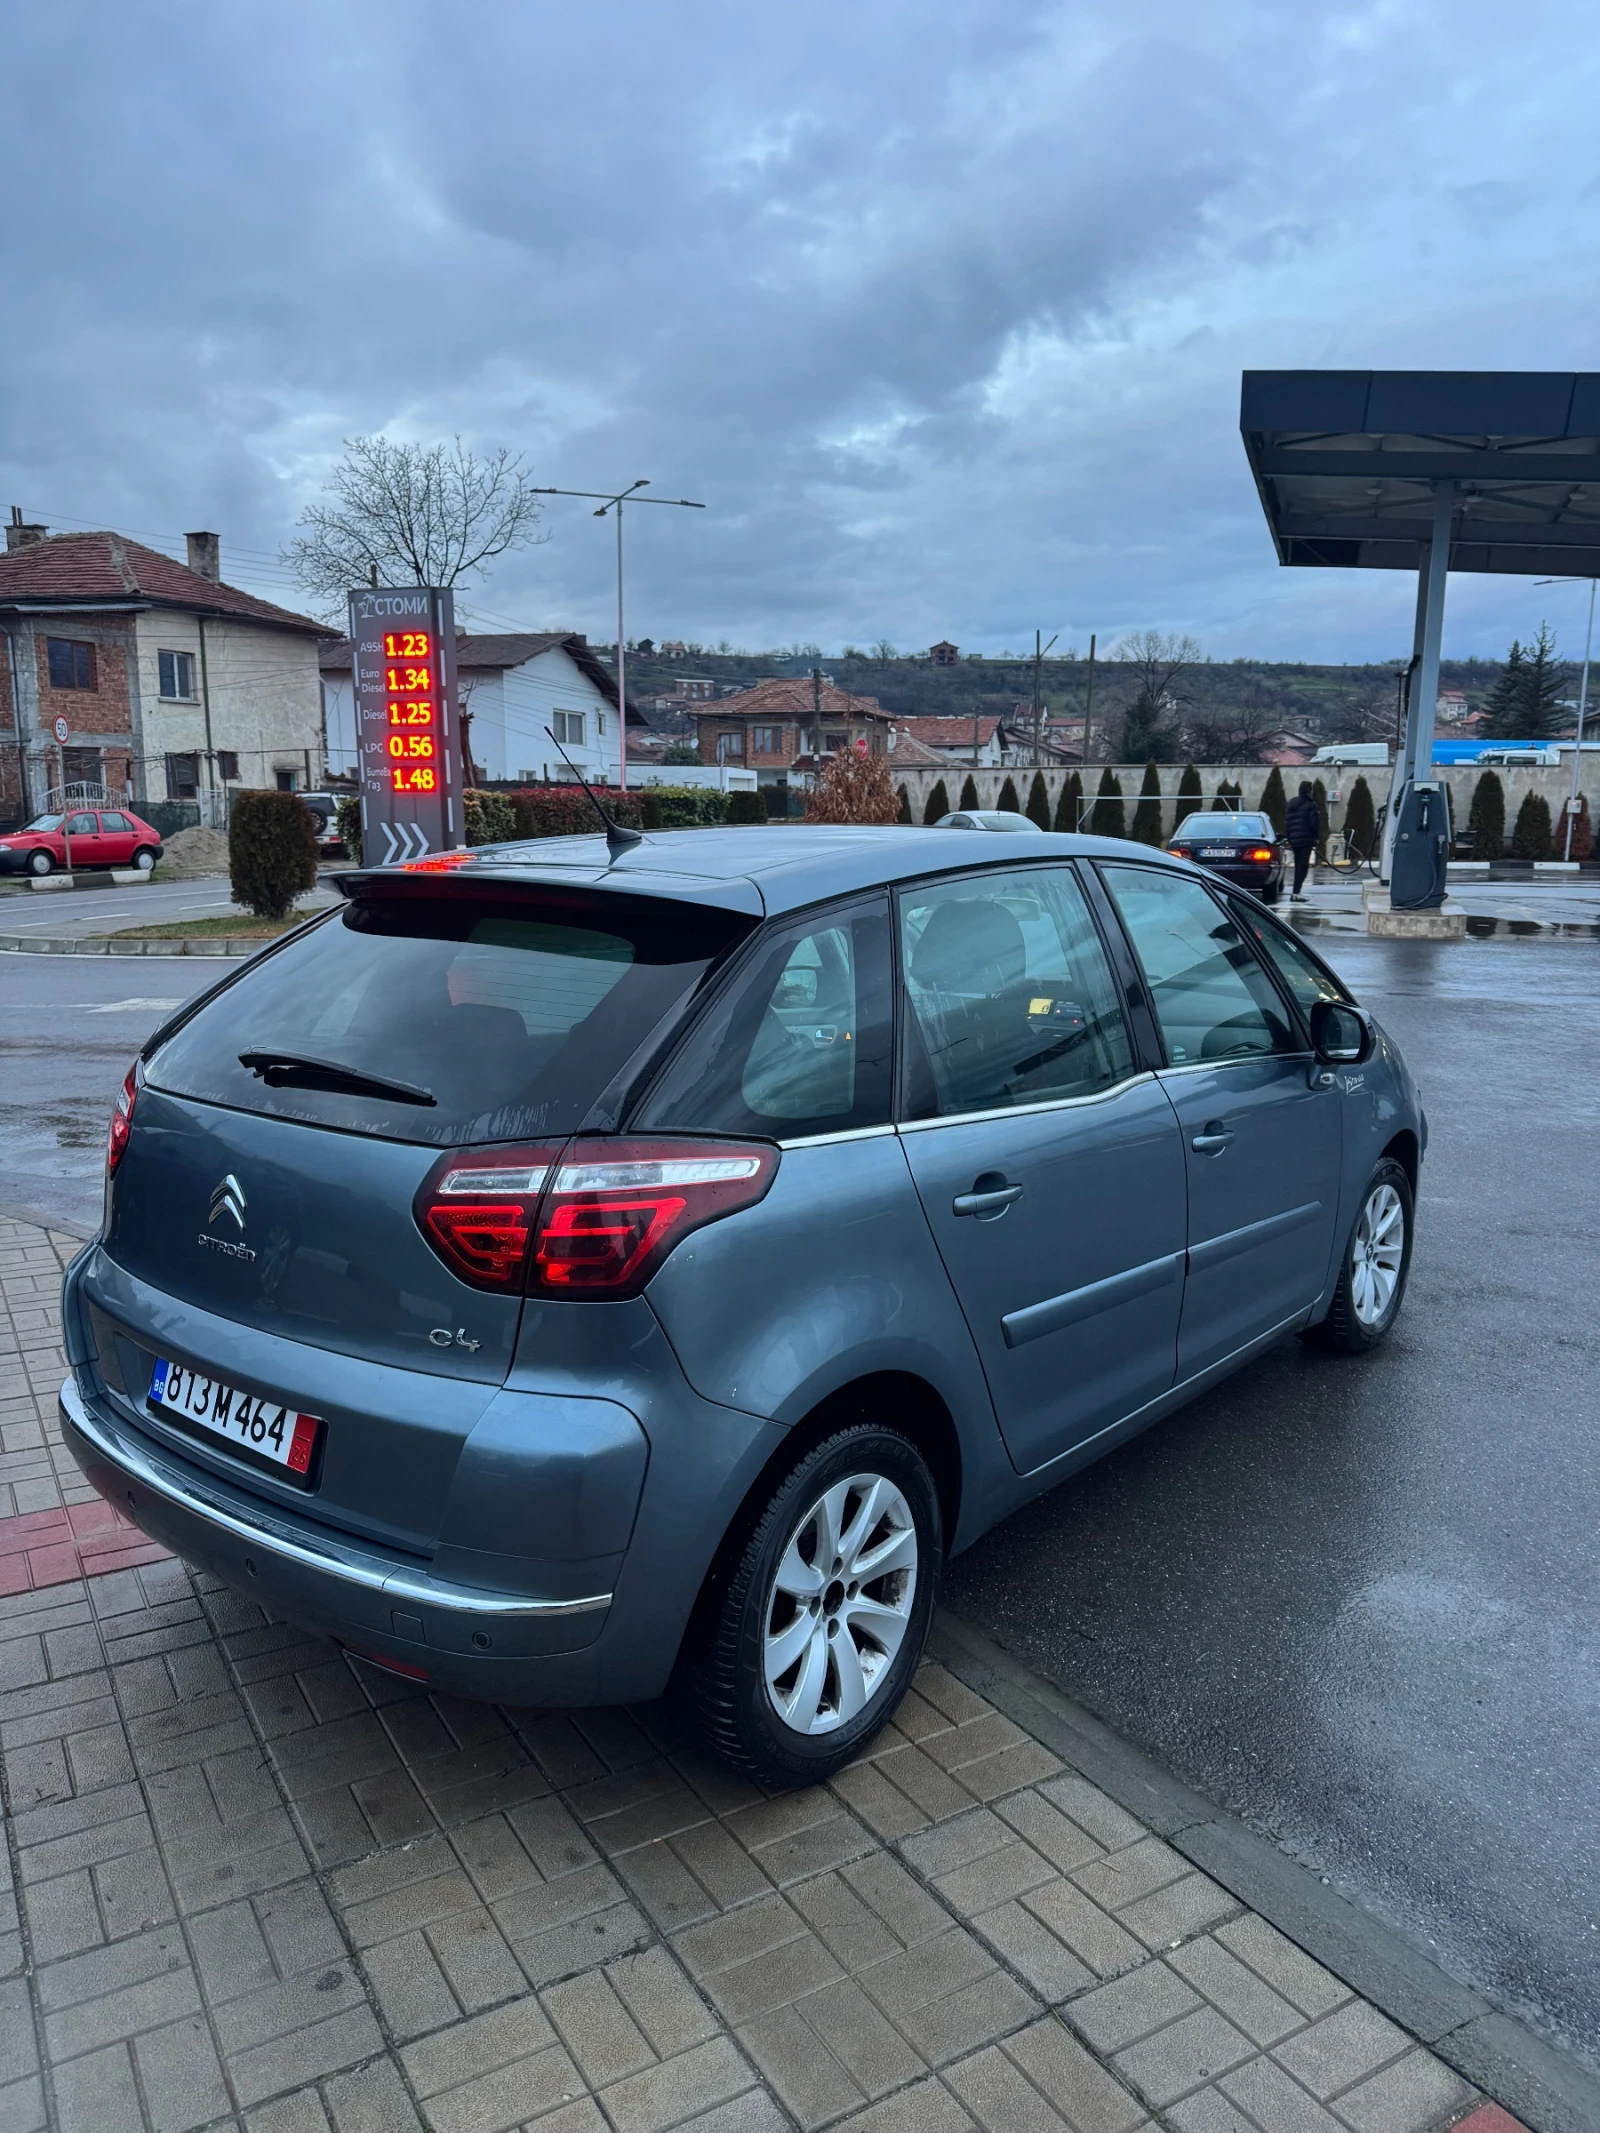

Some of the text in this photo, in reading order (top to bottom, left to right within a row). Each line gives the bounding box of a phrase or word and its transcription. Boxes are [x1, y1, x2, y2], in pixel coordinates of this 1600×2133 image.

[374, 597, 428, 616] СТОМИ
[385, 634, 428, 656] 1.23
[360, 668, 380, 679] Euro
[361, 668, 430, 693] Diesel 1.34
[363, 702, 431, 724] Diesel 1.25
[57, 722, 66, 737] 50
[364, 736, 433, 757] LPG 0.56
[393, 768, 435, 789] 1.48
[429, 1328, 483, 1353] C4
[153, 1378, 165, 1395] BG
